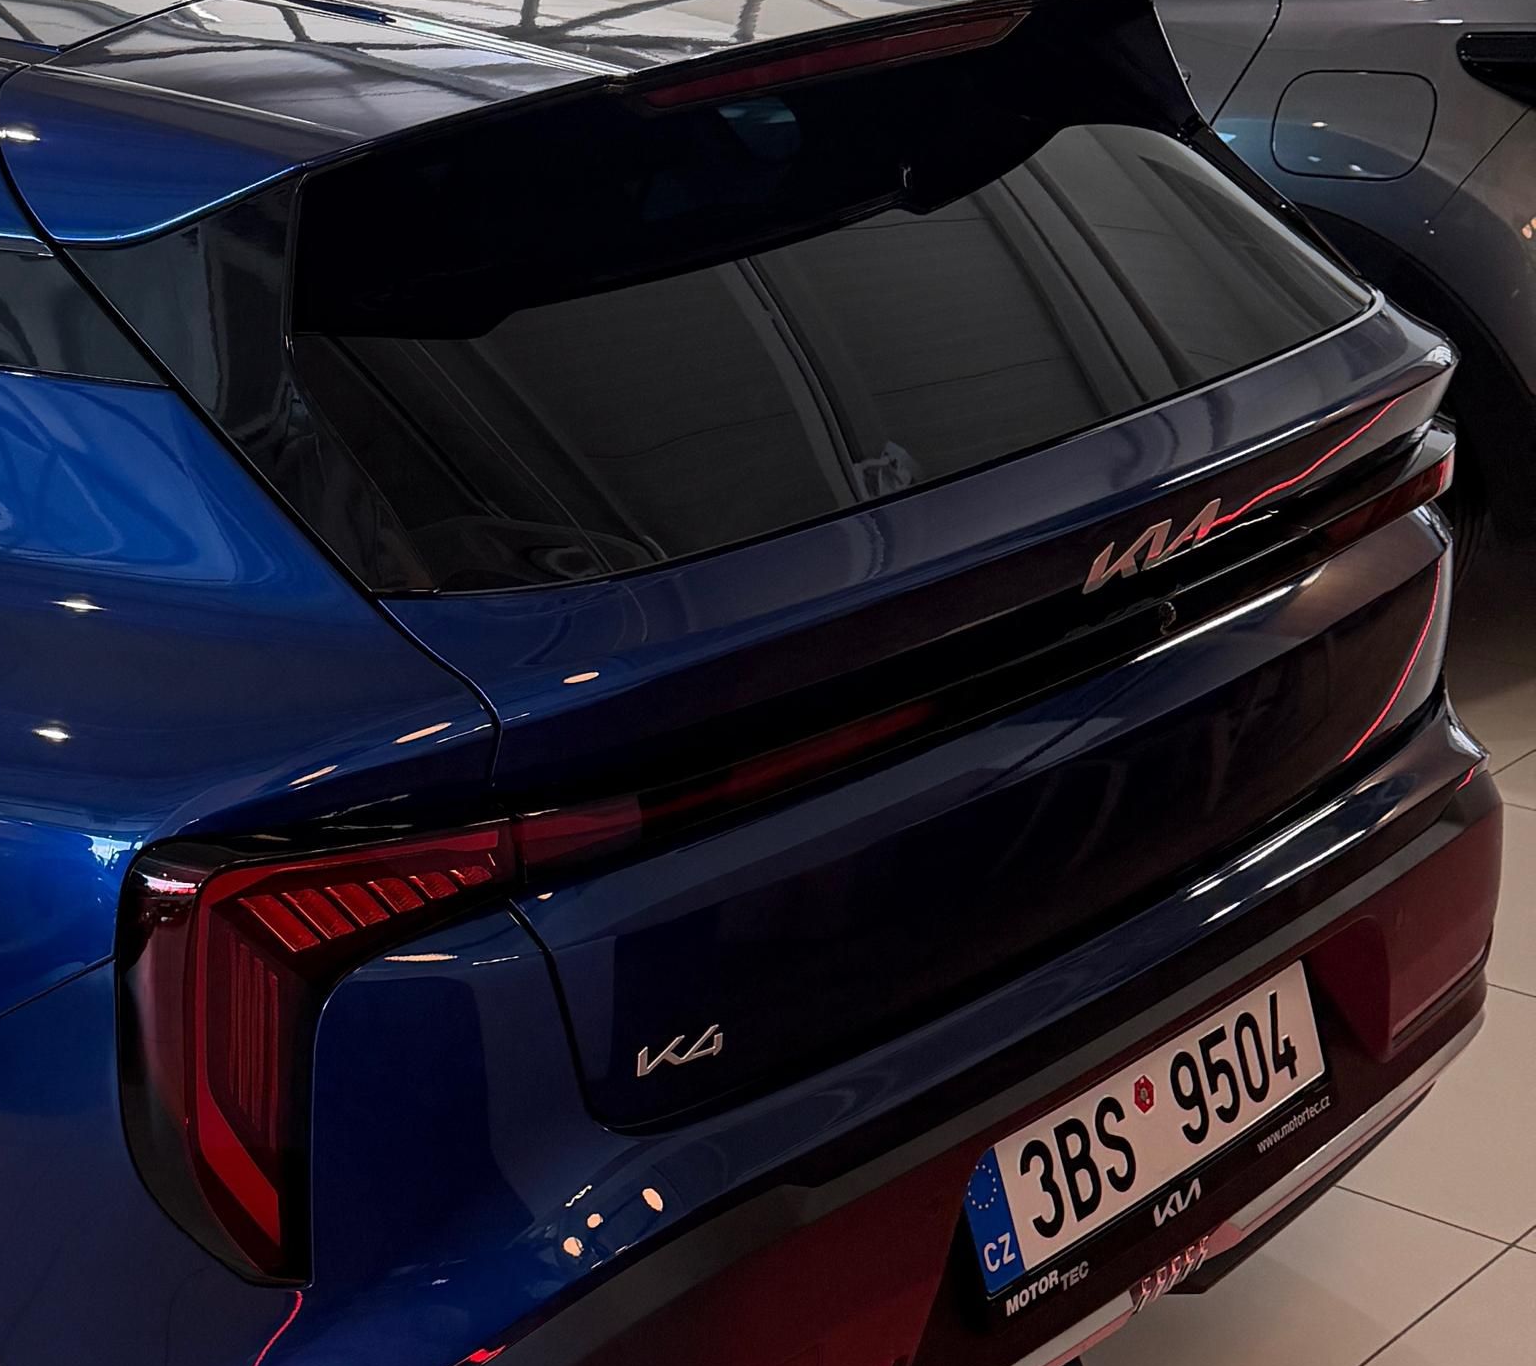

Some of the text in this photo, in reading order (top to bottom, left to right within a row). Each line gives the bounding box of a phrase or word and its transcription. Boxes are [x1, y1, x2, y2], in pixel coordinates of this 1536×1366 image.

[1082, 498, 1222, 595] KIA
[637, 1024, 723, 1077] K4
[1019, 990, 1299, 1239] 3BS 9504
[1256, 1095, 1331, 1154] www.motortec.cz
[1153, 1177, 1202, 1228] KIA
[984, 1232, 1016, 1273] CZ
[1005, 1261, 1089, 1317] MOTOR TEC
